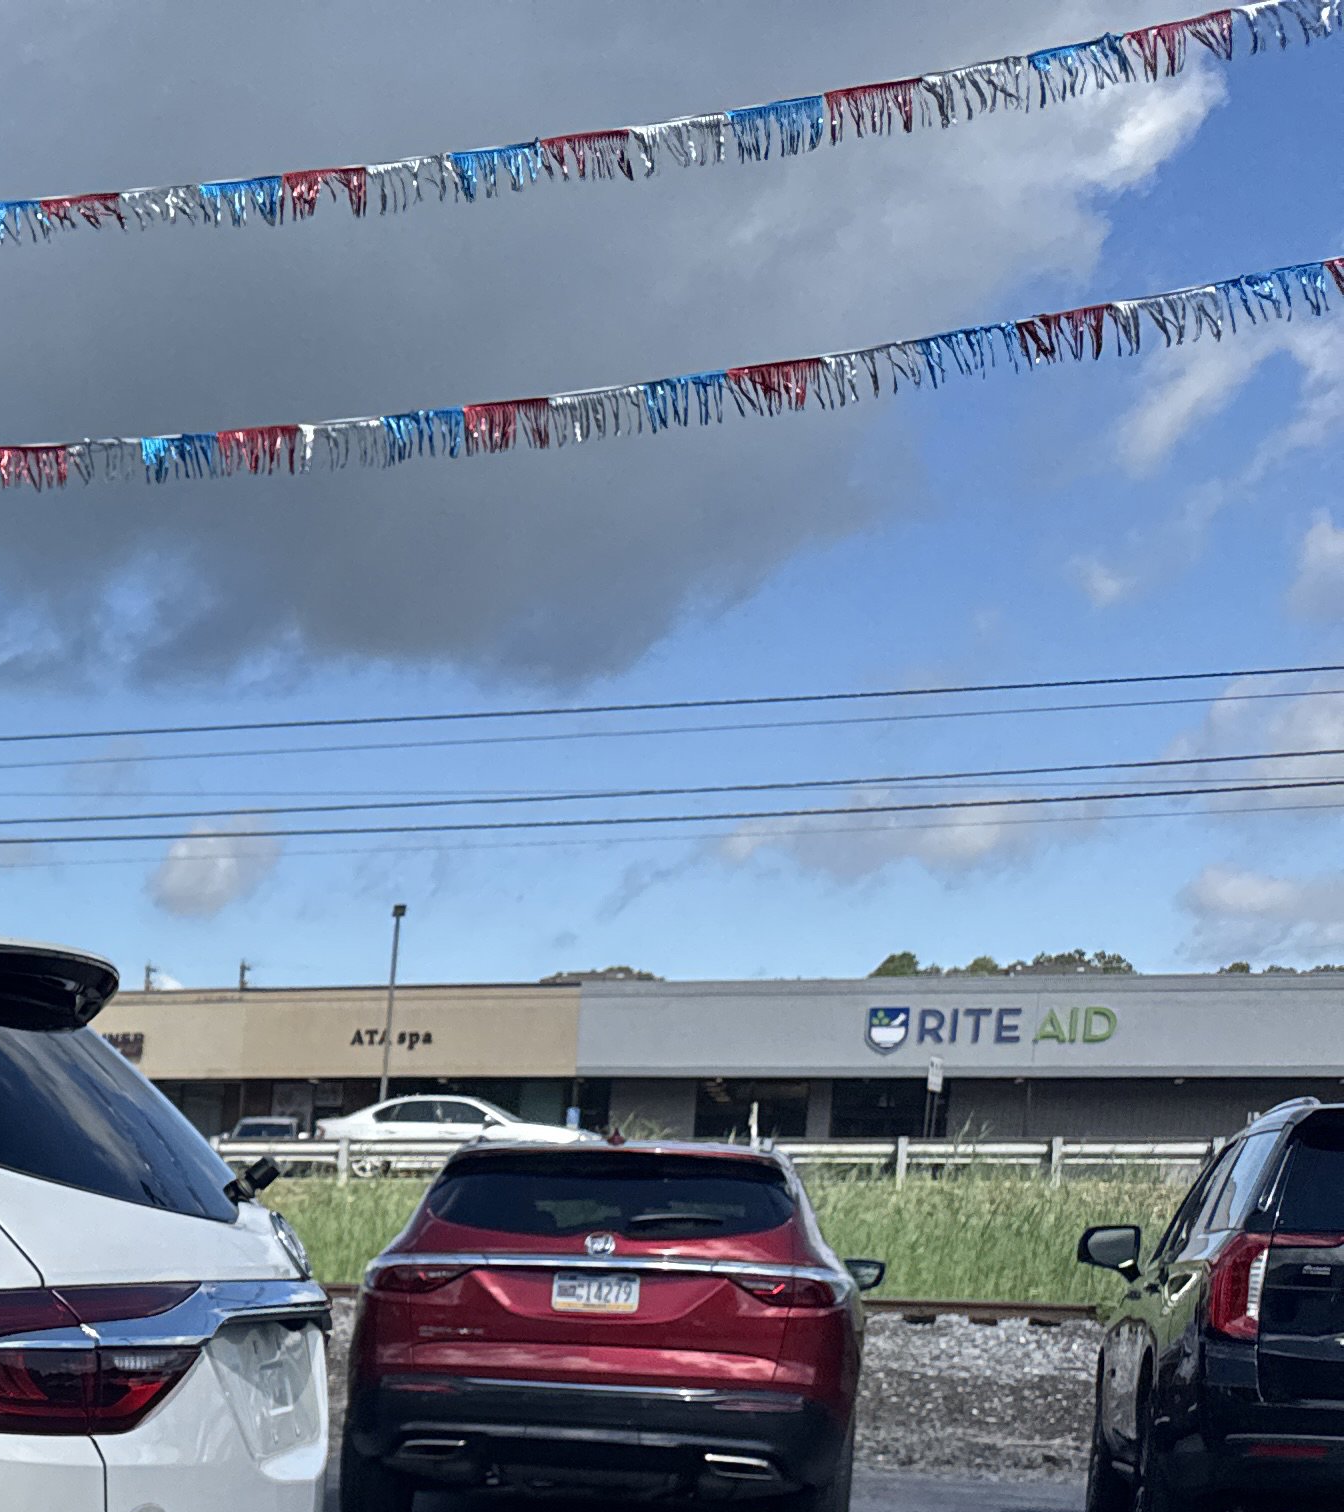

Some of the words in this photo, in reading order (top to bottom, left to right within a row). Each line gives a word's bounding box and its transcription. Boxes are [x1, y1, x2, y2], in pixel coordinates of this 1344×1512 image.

[916, 1007, 1023, 1045] RITE
[1034, 1005, 1118, 1044] AID
[396, 1031, 433, 1051] spa
